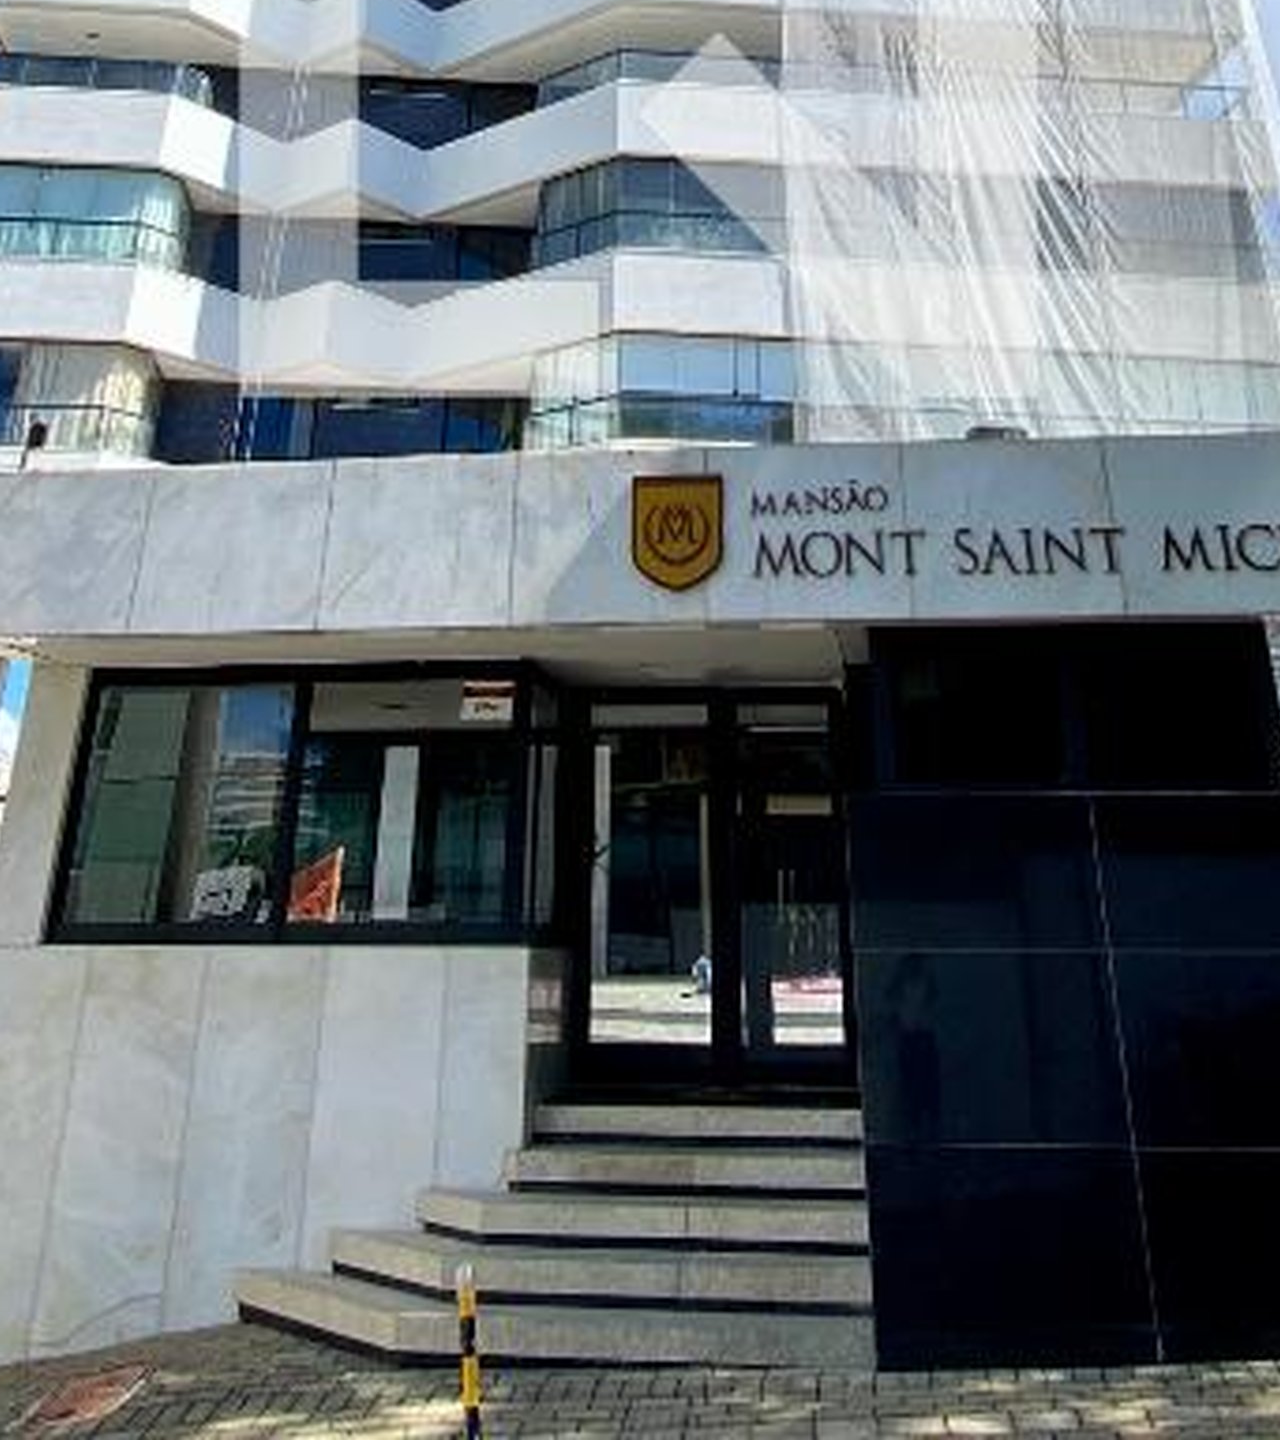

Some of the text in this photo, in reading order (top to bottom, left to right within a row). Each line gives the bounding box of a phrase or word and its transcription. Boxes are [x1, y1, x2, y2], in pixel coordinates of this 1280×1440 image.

[751, 480, 889, 516] MANSÃO
[754, 529, 924, 578] MONT
[953, 527, 1124, 575] SAINT
